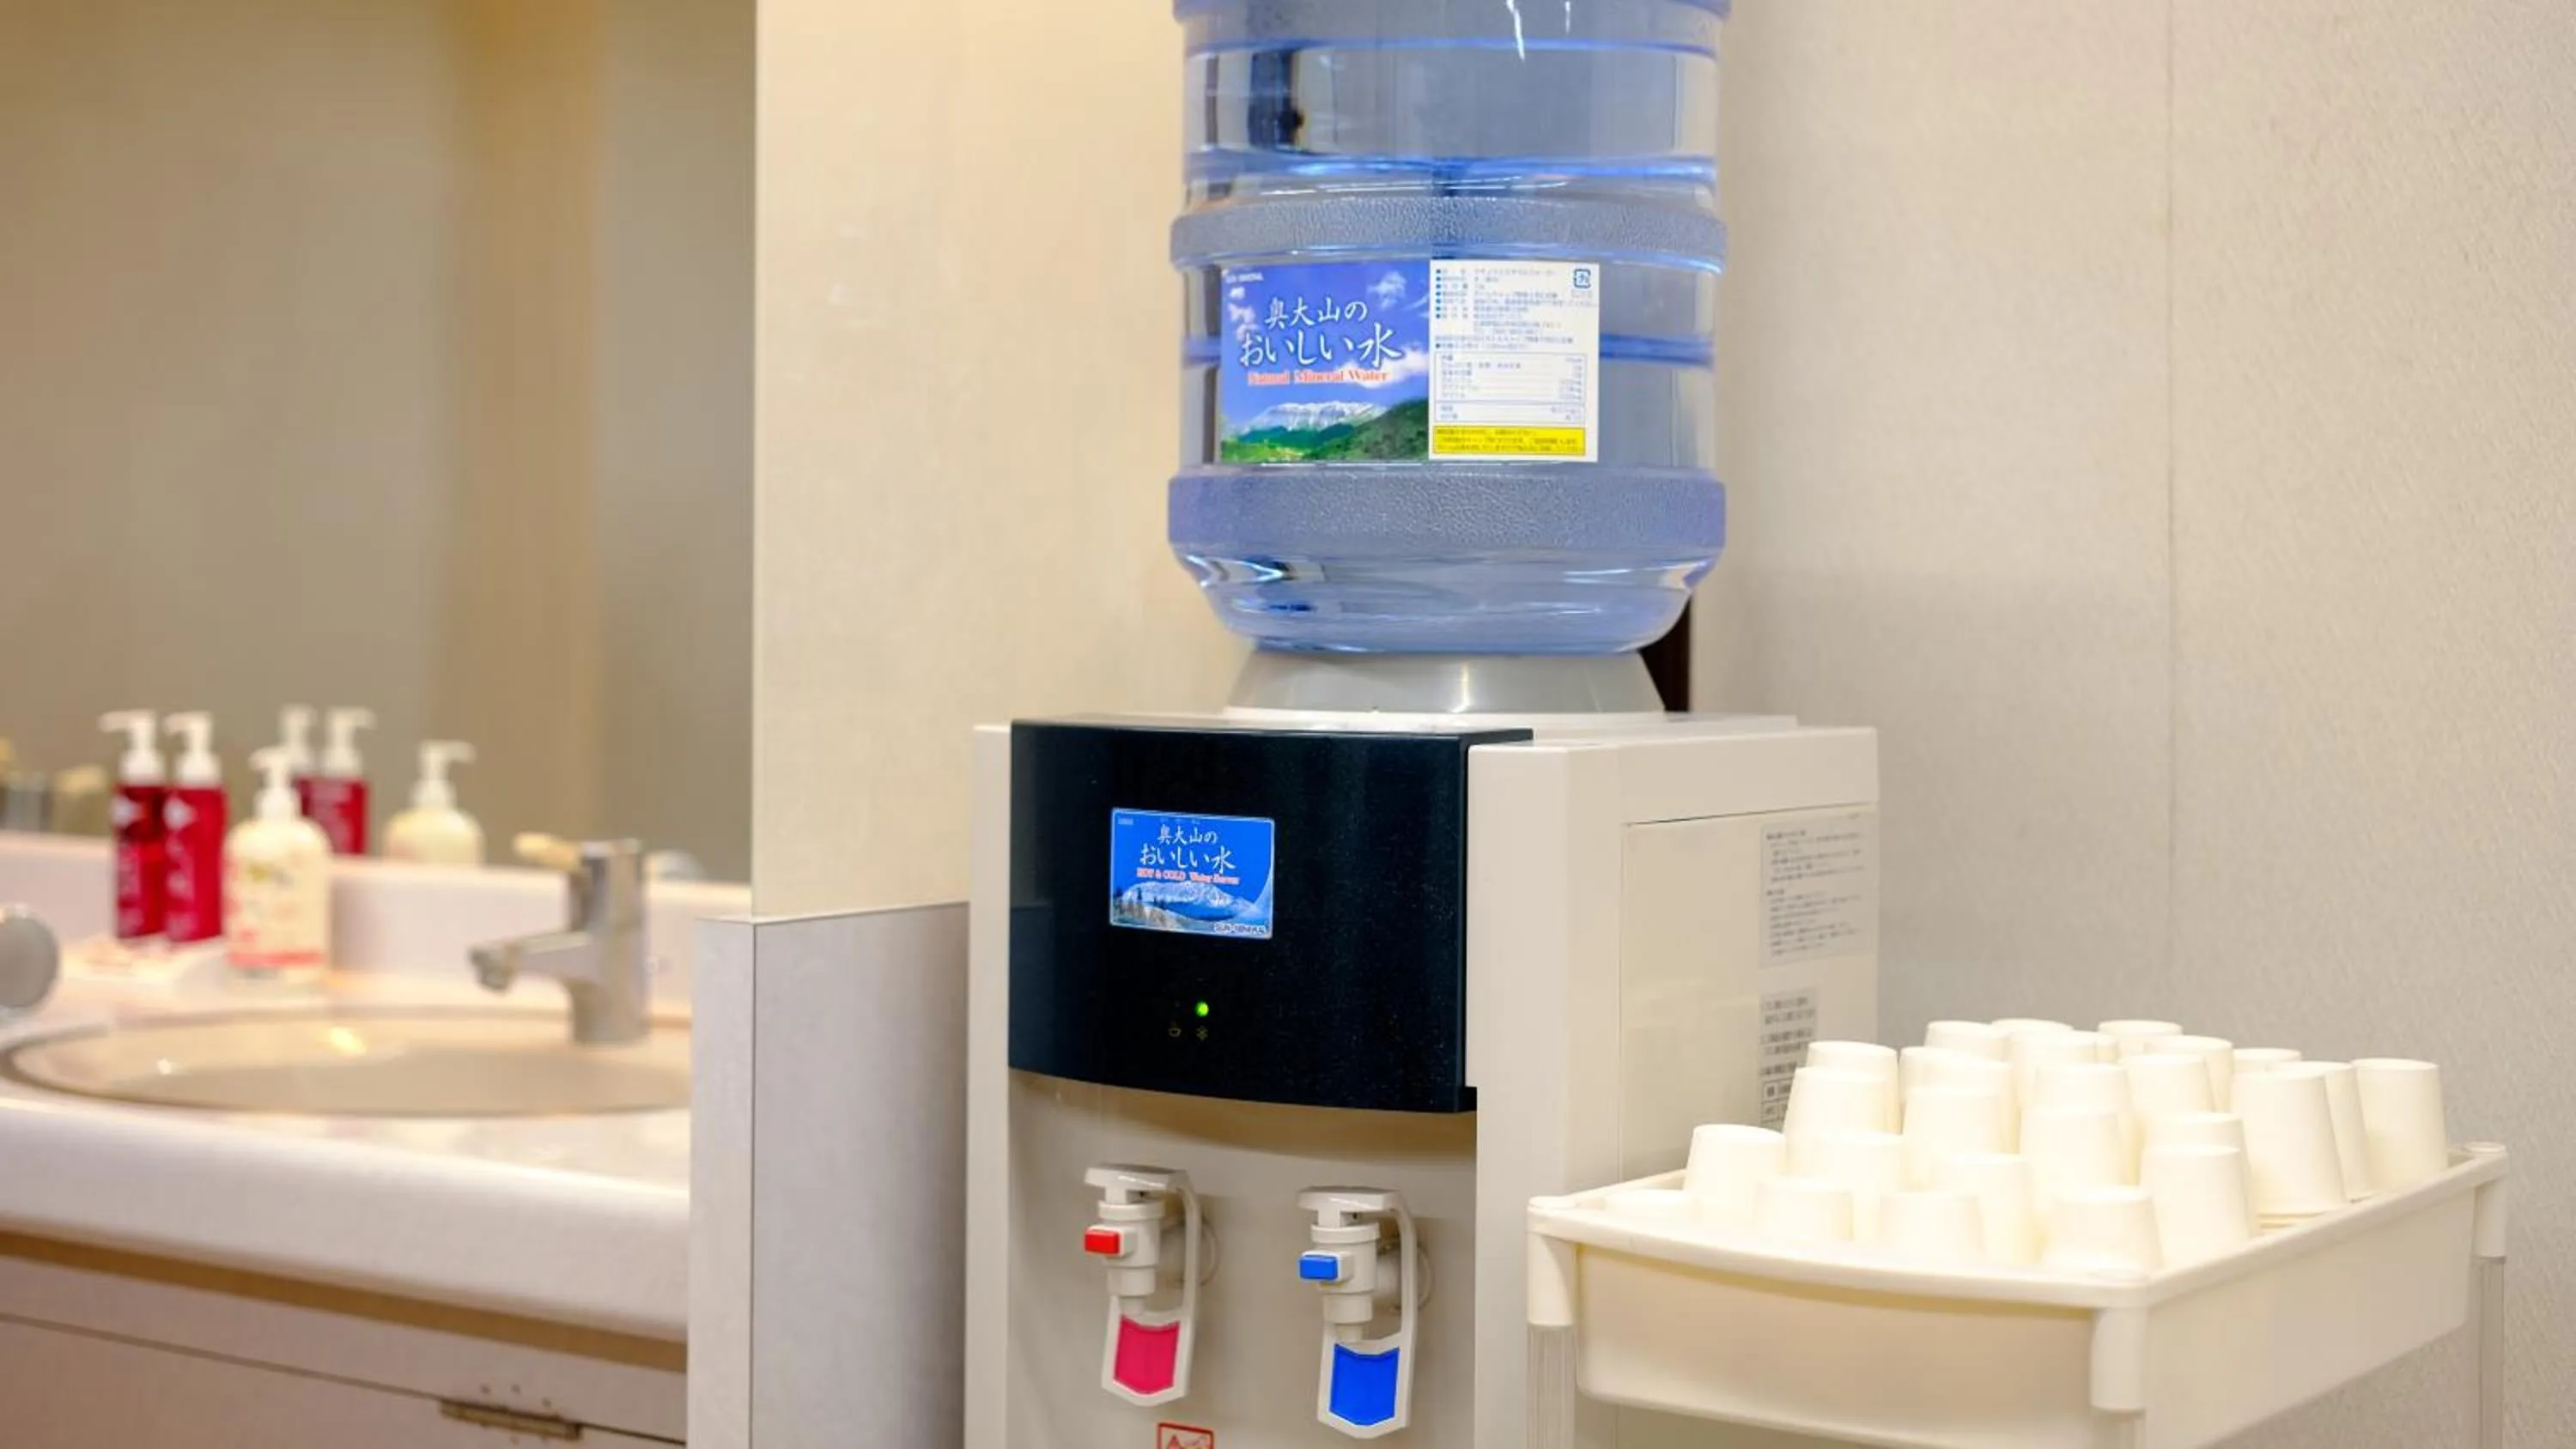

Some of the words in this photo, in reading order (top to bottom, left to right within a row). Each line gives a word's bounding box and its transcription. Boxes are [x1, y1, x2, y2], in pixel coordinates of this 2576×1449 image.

[1265, 296, 1368, 330] 奥大山の
[1240, 323, 1402, 368] おいしい水
[1294, 369, 1344, 383] Mineral
[1348, 369, 1388, 381] Water
[1157, 823, 1218, 845] 奥大山の
[1140, 843, 1236, 873] おいしい水
